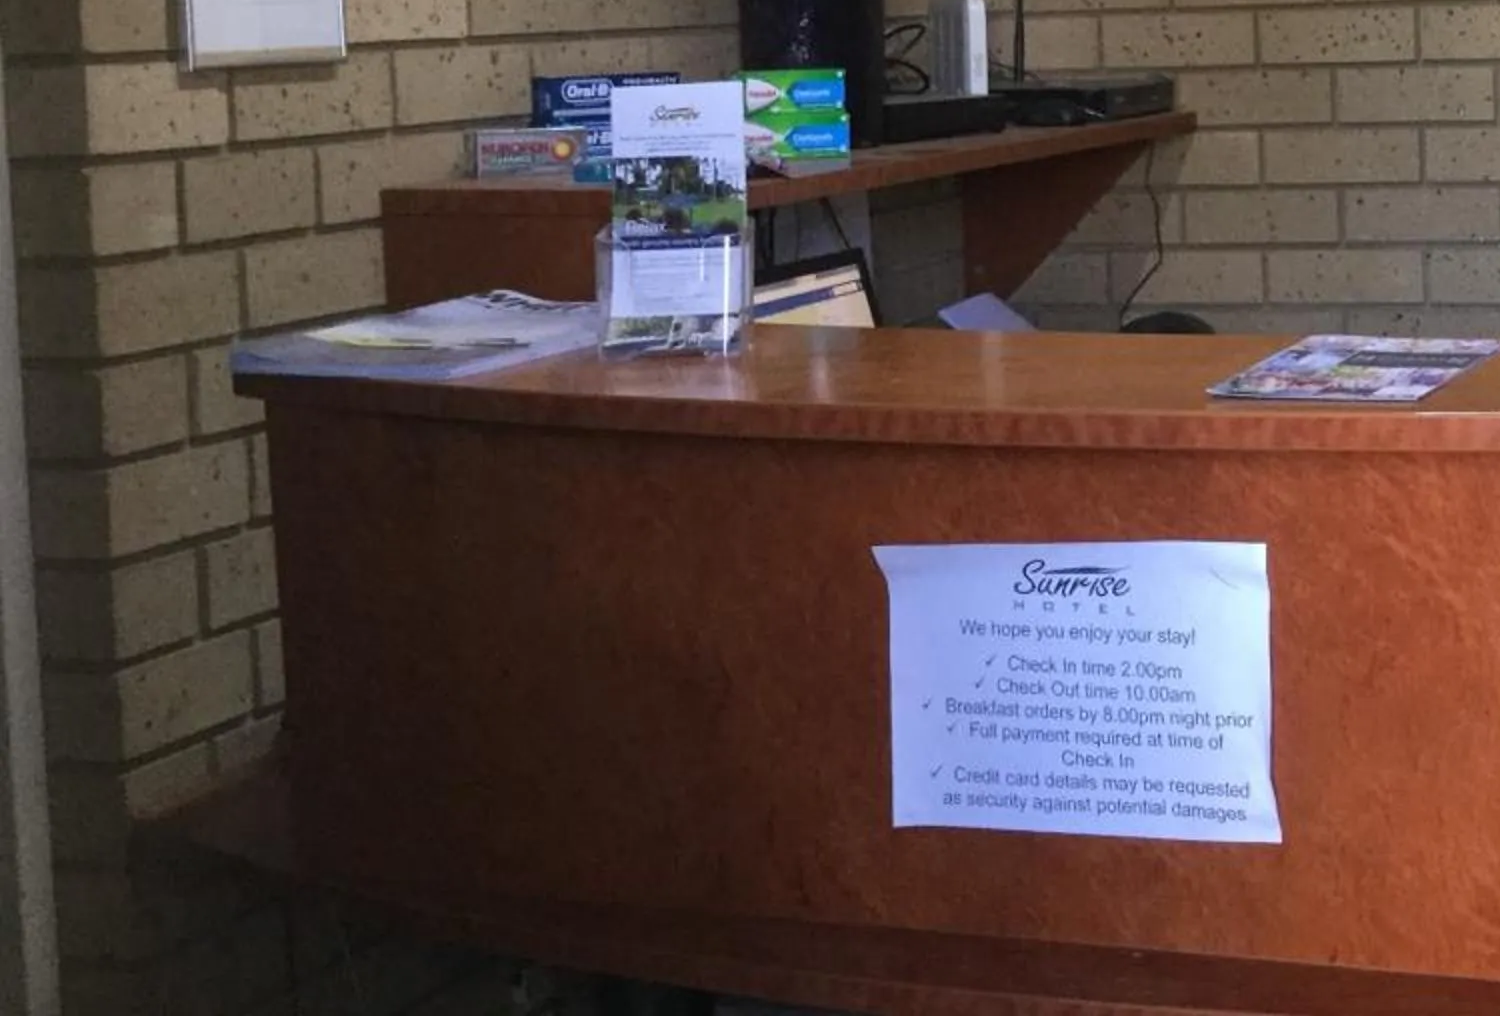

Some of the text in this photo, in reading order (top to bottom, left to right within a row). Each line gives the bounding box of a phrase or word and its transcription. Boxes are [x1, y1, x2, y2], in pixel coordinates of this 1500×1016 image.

[1013, 559, 1132, 597] Sunrise
[960, 619, 1196, 648] We hope you enjoy your stay!
[1008, 655, 1182, 681] Check In time 2.00pm
[997, 677, 1196, 703] Check Out time 10.00am
[945, 697, 1254, 731] Breakfast orders by 8.00pm night prior
[969, 721, 1224, 750] Full payment required at time of
[1061, 750, 1135, 769] Check In
[953, 765, 1250, 799] Credit card details may be requested
[943, 791, 1248, 824] as security against potential damages
